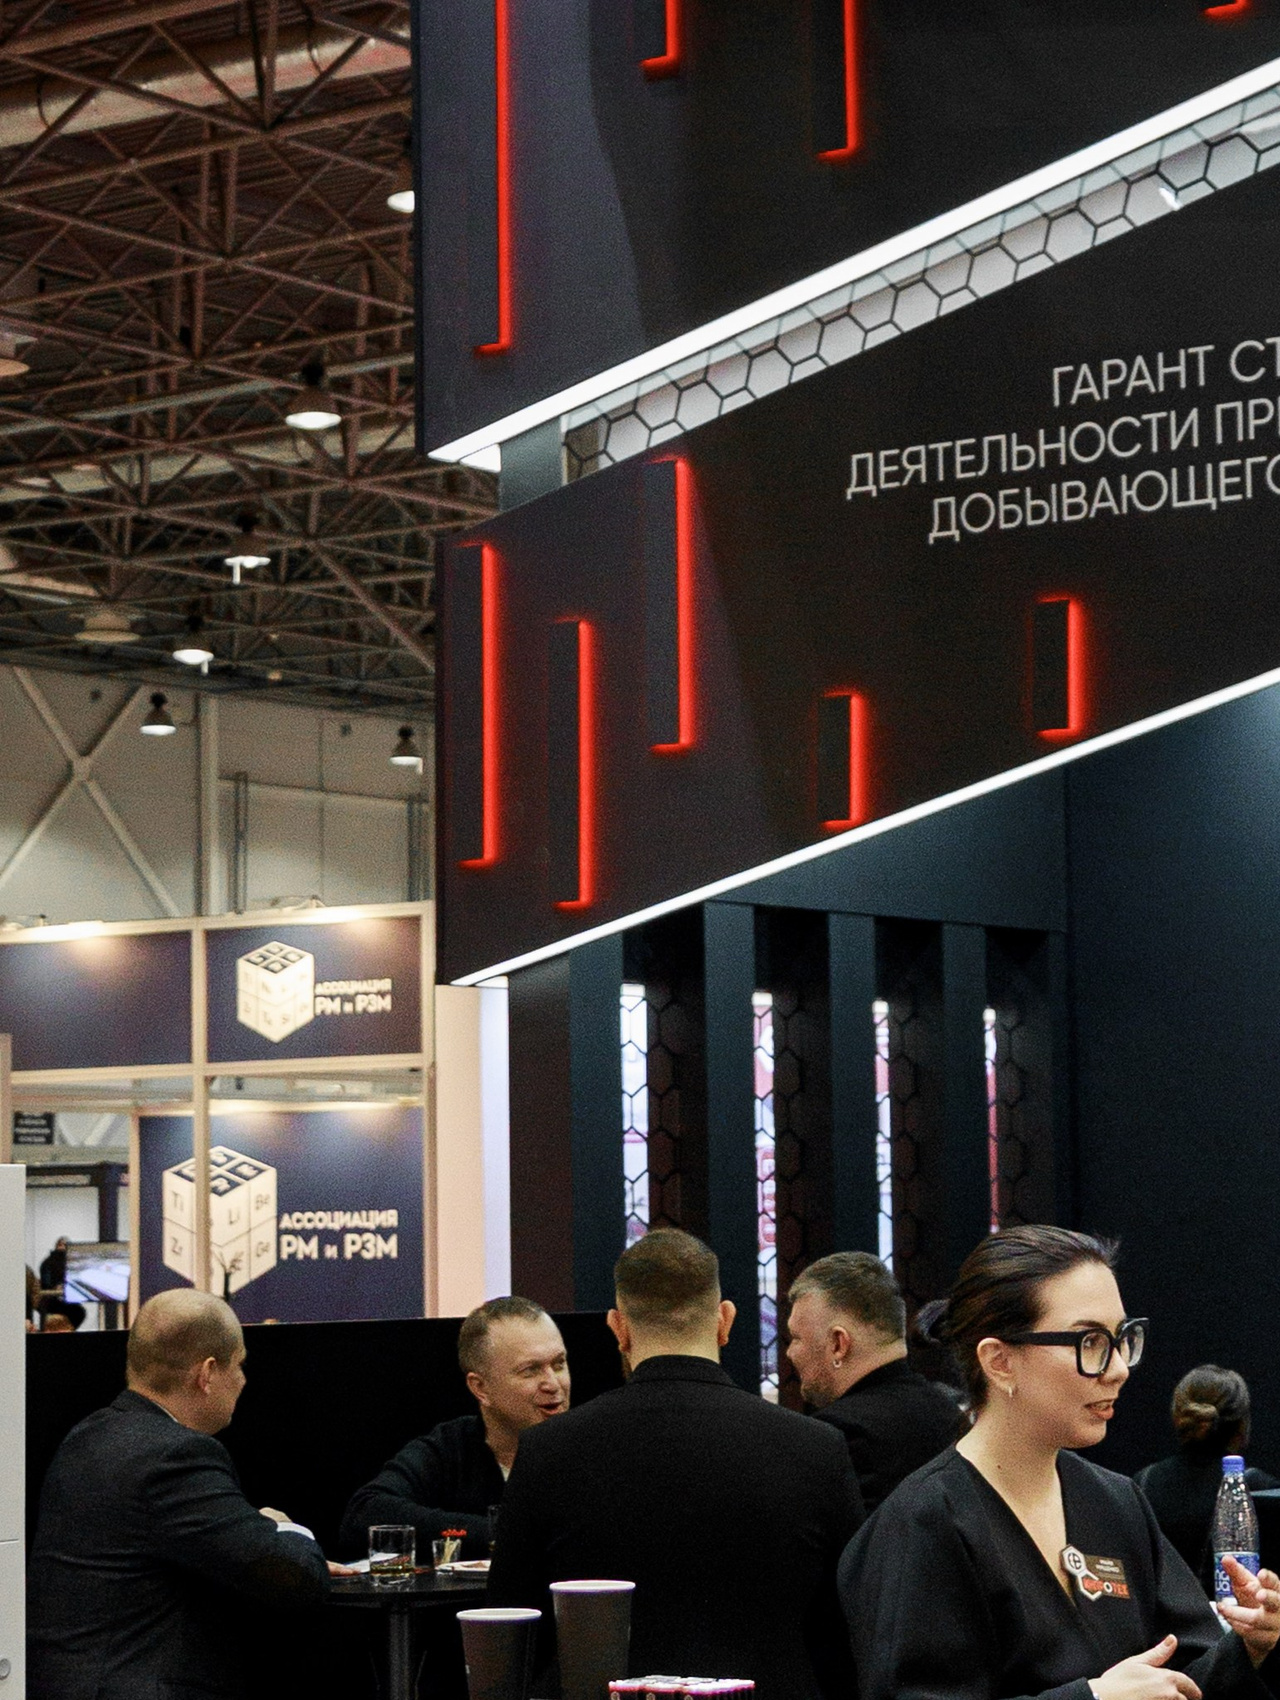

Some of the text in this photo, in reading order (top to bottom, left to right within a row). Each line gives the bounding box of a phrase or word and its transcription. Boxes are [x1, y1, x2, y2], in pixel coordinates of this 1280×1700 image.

[1053, 344, 1215, 407] ГАРАНТ
[846, 407, 1199, 500] ДЕЯТЕЛЬНОСТИ
[315, 996, 341, 1015] РМ
[279, 1209, 398, 1231] АССОЦИАЦИЯ
[280, 1232, 398, 1260] РМ и РЗМ
